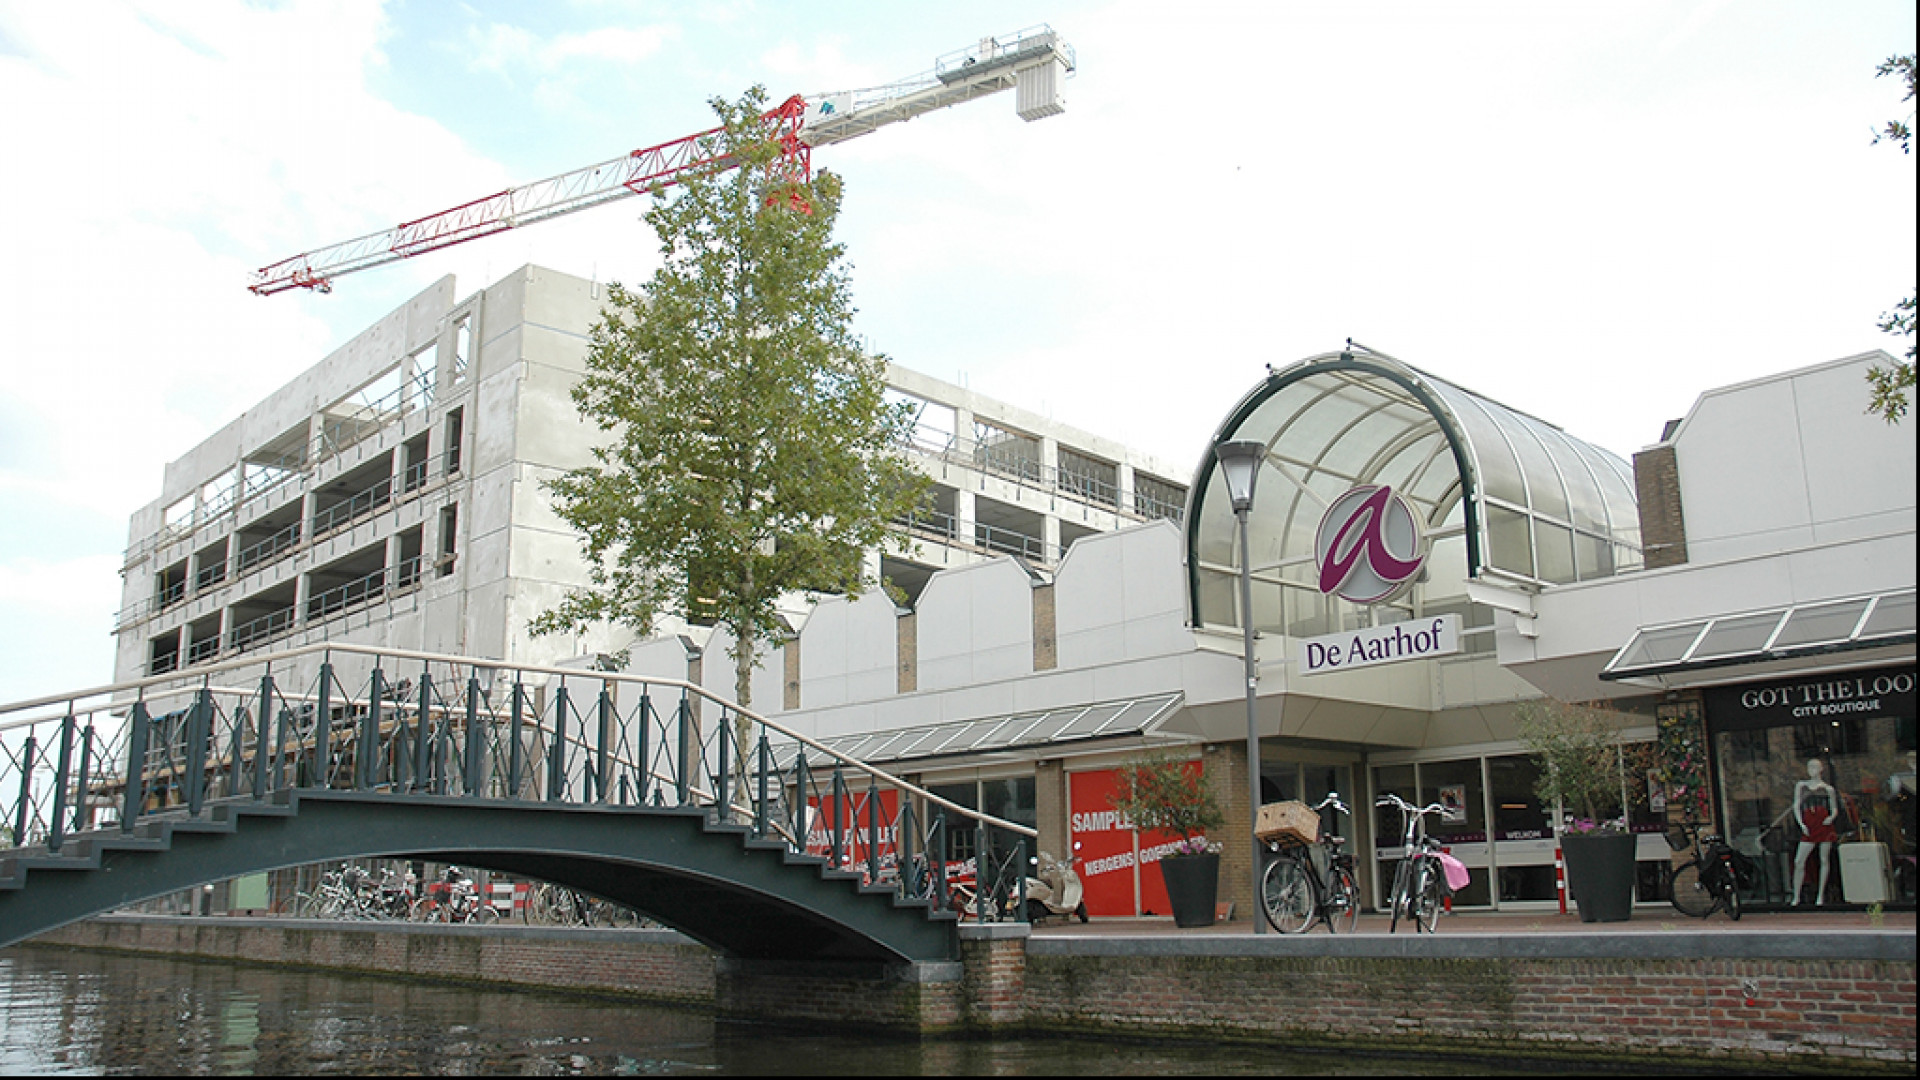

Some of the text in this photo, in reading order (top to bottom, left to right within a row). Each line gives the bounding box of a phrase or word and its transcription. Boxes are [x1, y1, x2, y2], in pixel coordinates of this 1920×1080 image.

[1306, 618, 1443, 669] De Aarhof
[1741, 673, 1917, 709] GOT THE LOO
[1792, 699, 1882, 718] CITY BOUTIQUE
[1072, 809, 1135, 832] SAMPLE
[1505, 830, 1542, 840] WELKOM
[1084, 852, 1135, 877] NERGENS
